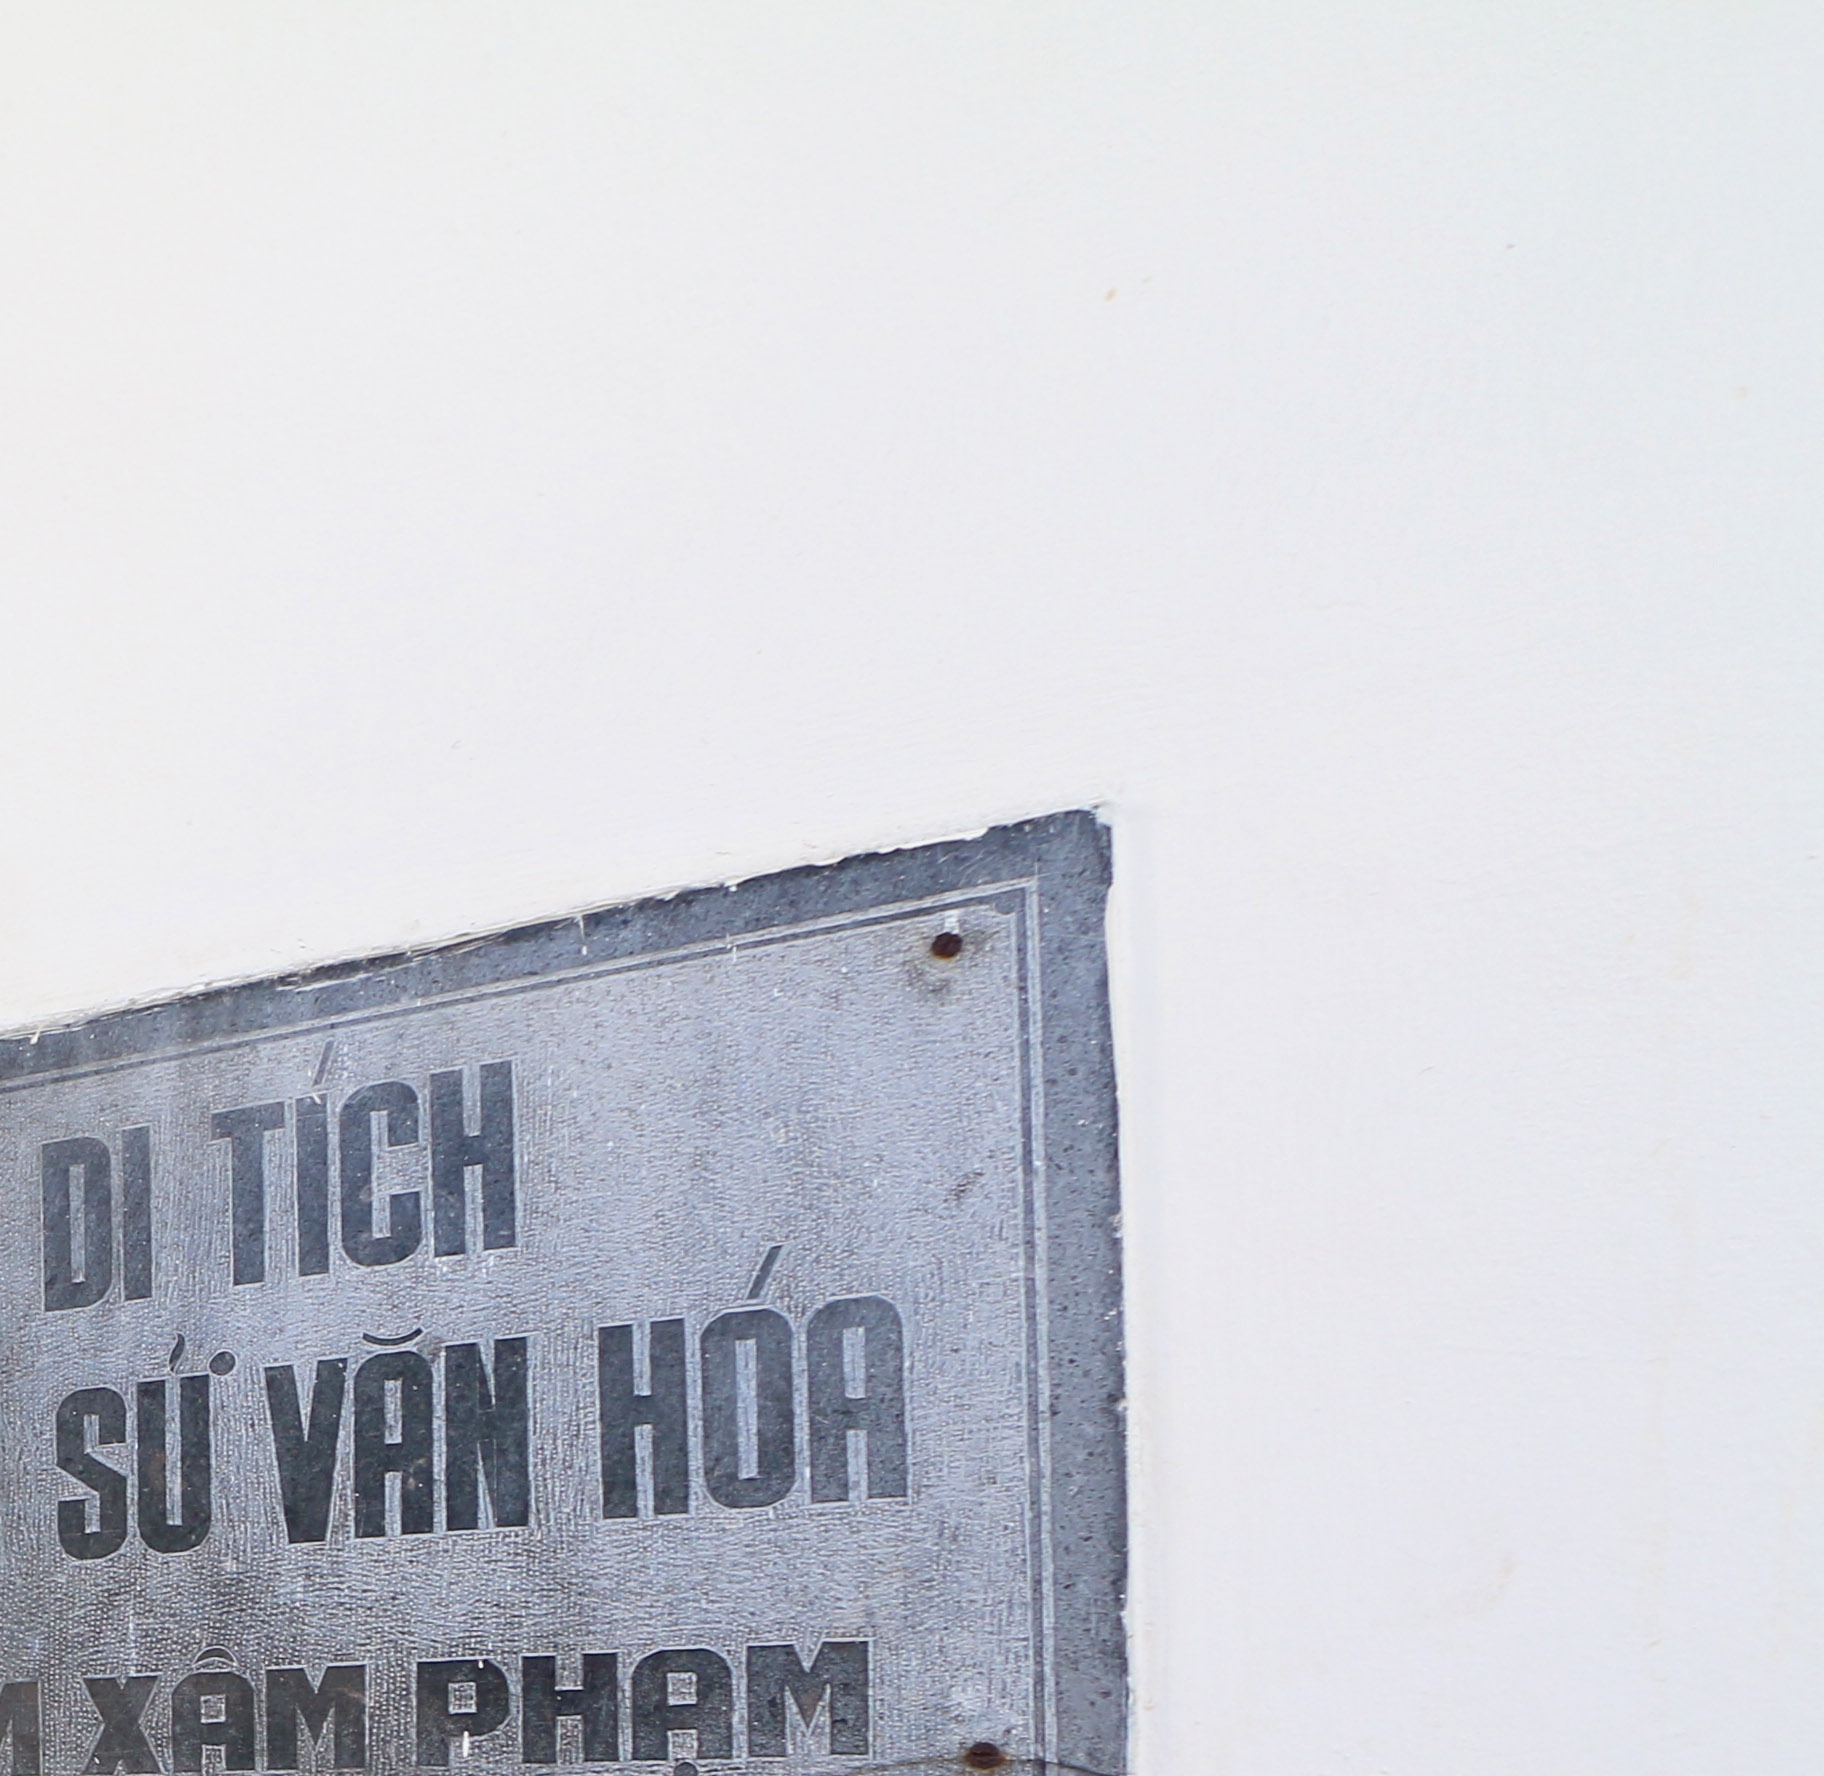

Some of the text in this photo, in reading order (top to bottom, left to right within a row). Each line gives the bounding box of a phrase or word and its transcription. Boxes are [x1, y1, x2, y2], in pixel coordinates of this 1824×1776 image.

[37, 1040, 517, 1313] DI TÍCH
[263, 1327, 532, 1544] VĂN
[597, 1244, 909, 1520] HÓA
[81, 1645, 370, 1776] XÂM
